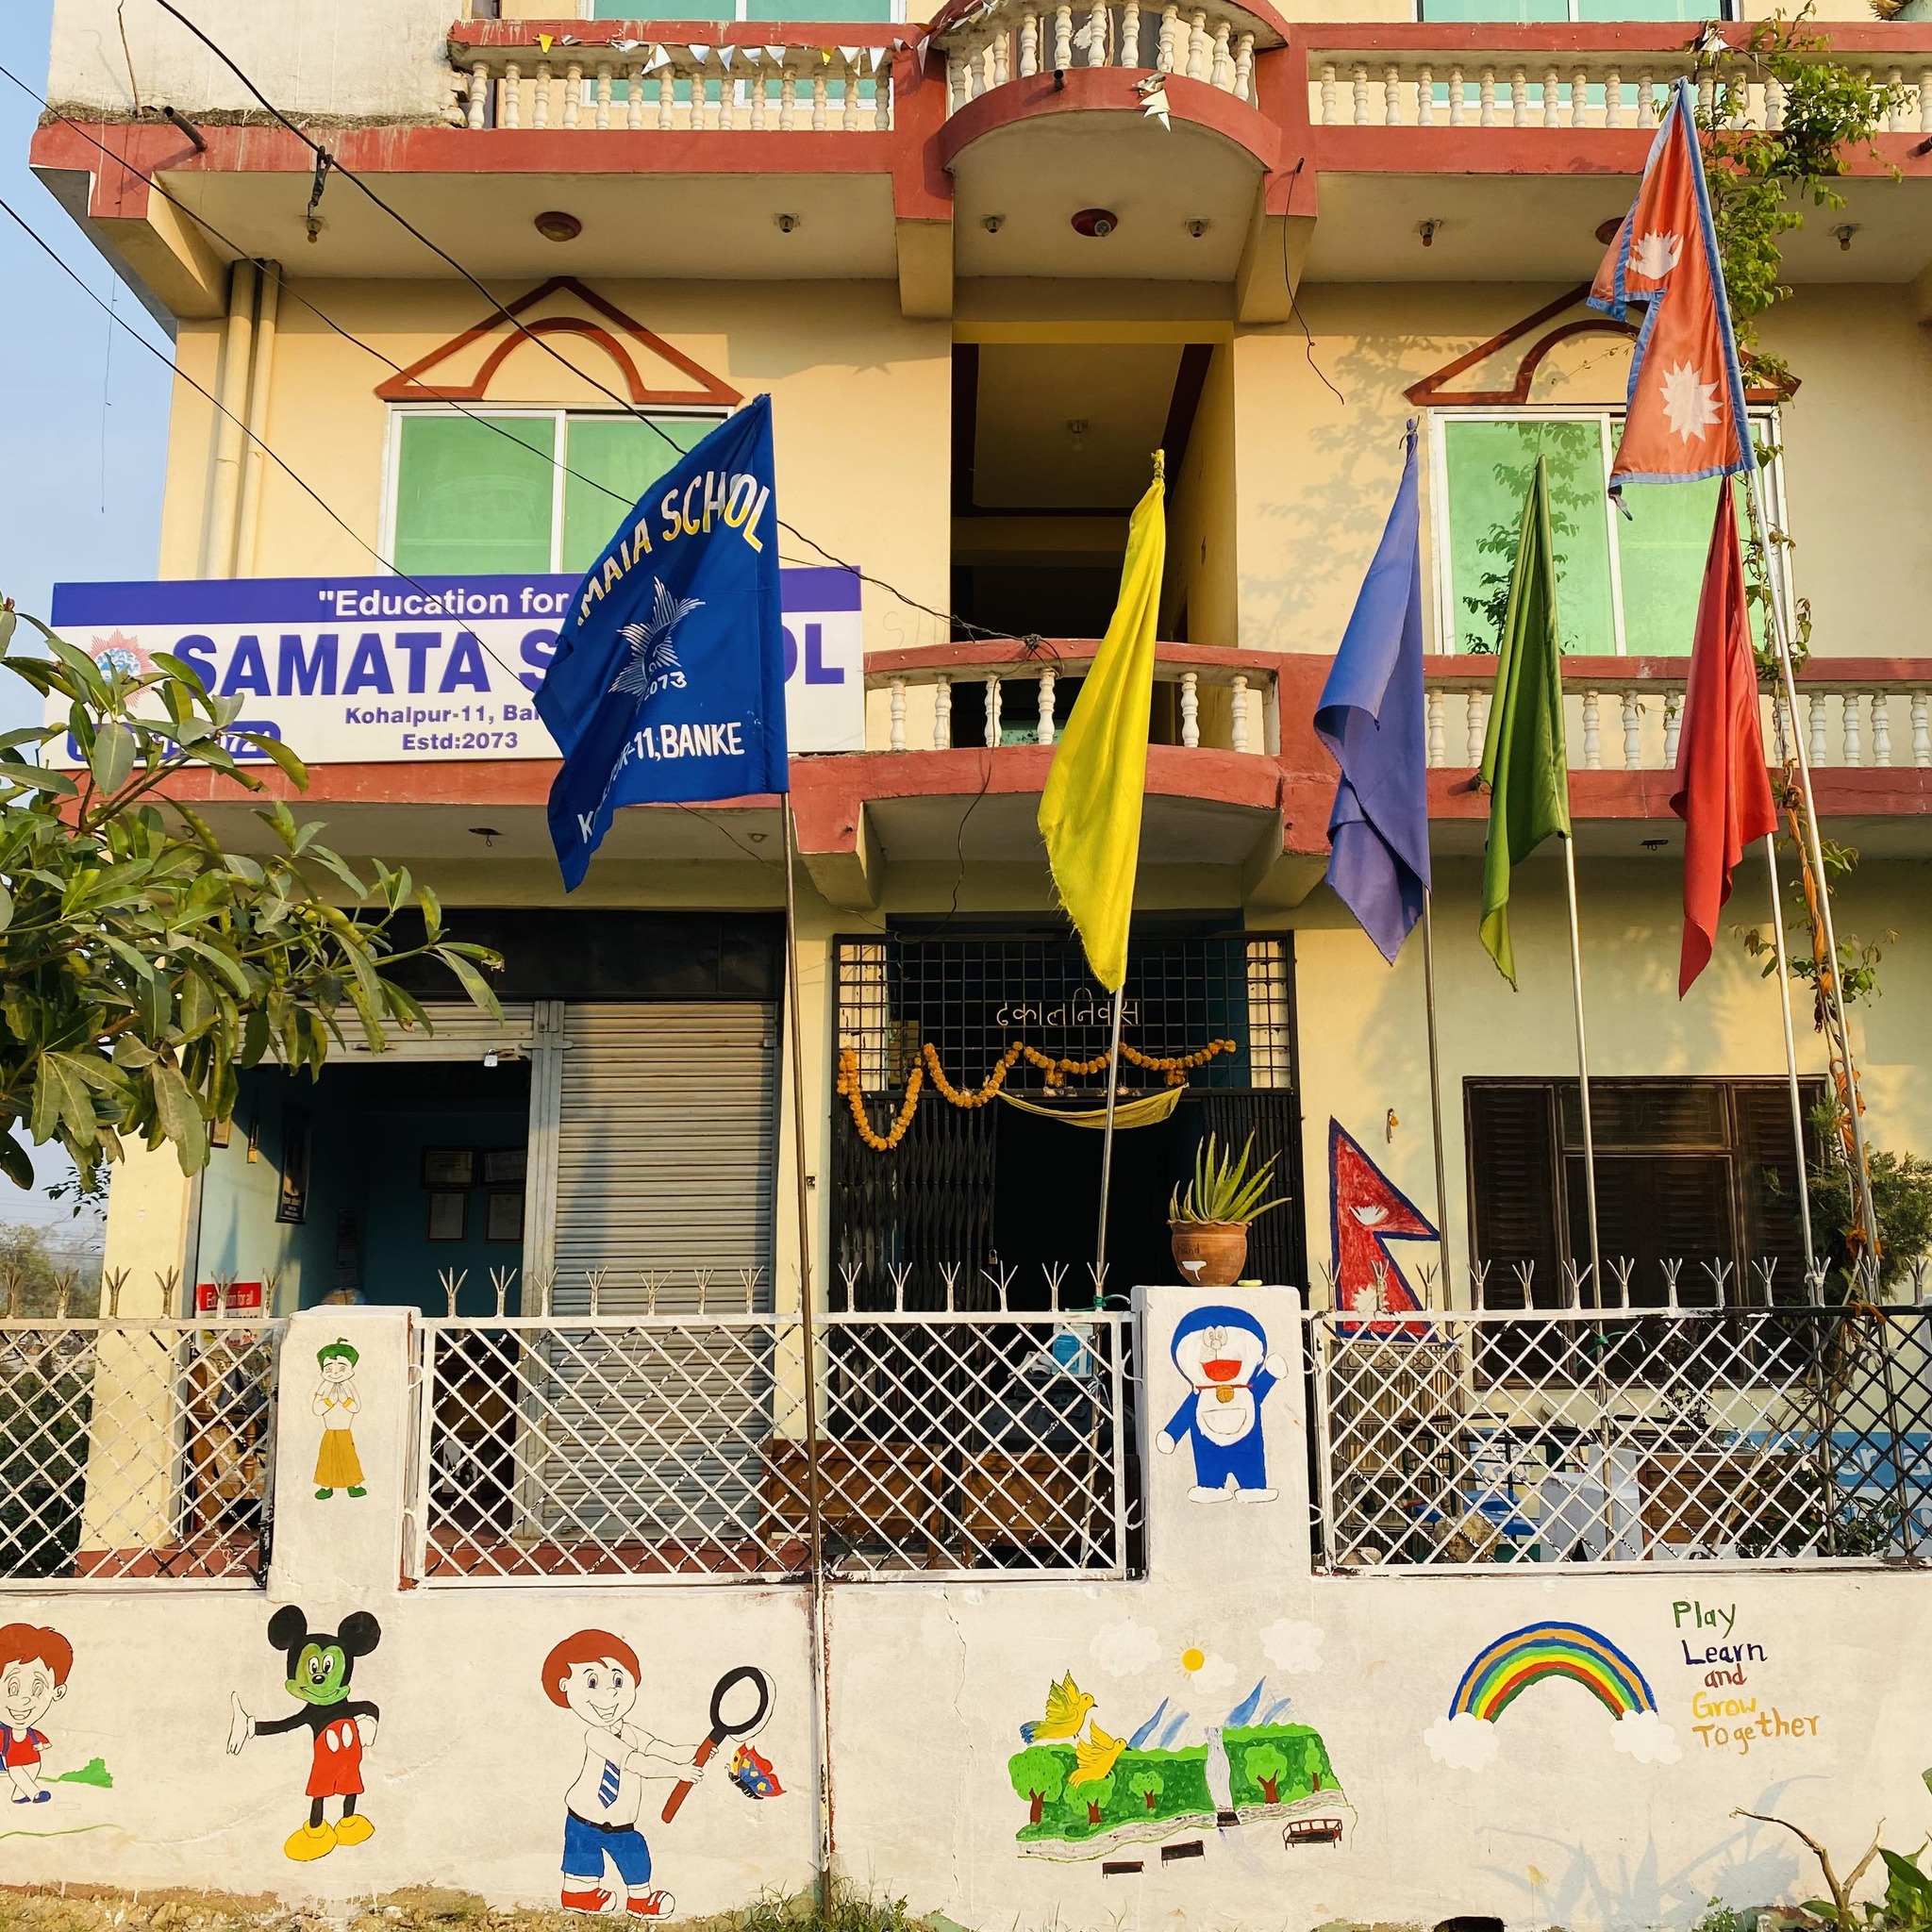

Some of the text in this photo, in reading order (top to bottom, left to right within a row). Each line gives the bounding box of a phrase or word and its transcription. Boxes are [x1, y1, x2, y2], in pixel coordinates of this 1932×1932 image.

[319, 588, 569, 616] "Education for
[174, 631, 491, 699] SAMATA
[643, 671, 688, 701] 073
[345, 706, 494, 726] Kohalpur-11,
[402, 732, 518, 750] Estd:2073
[1673, 1600, 1736, 1639] Play
[1681, 1640, 1768, 1665] Learn
[1704, 1663, 1748, 1688] and
[1691, 1691, 1757, 1719] Grow
